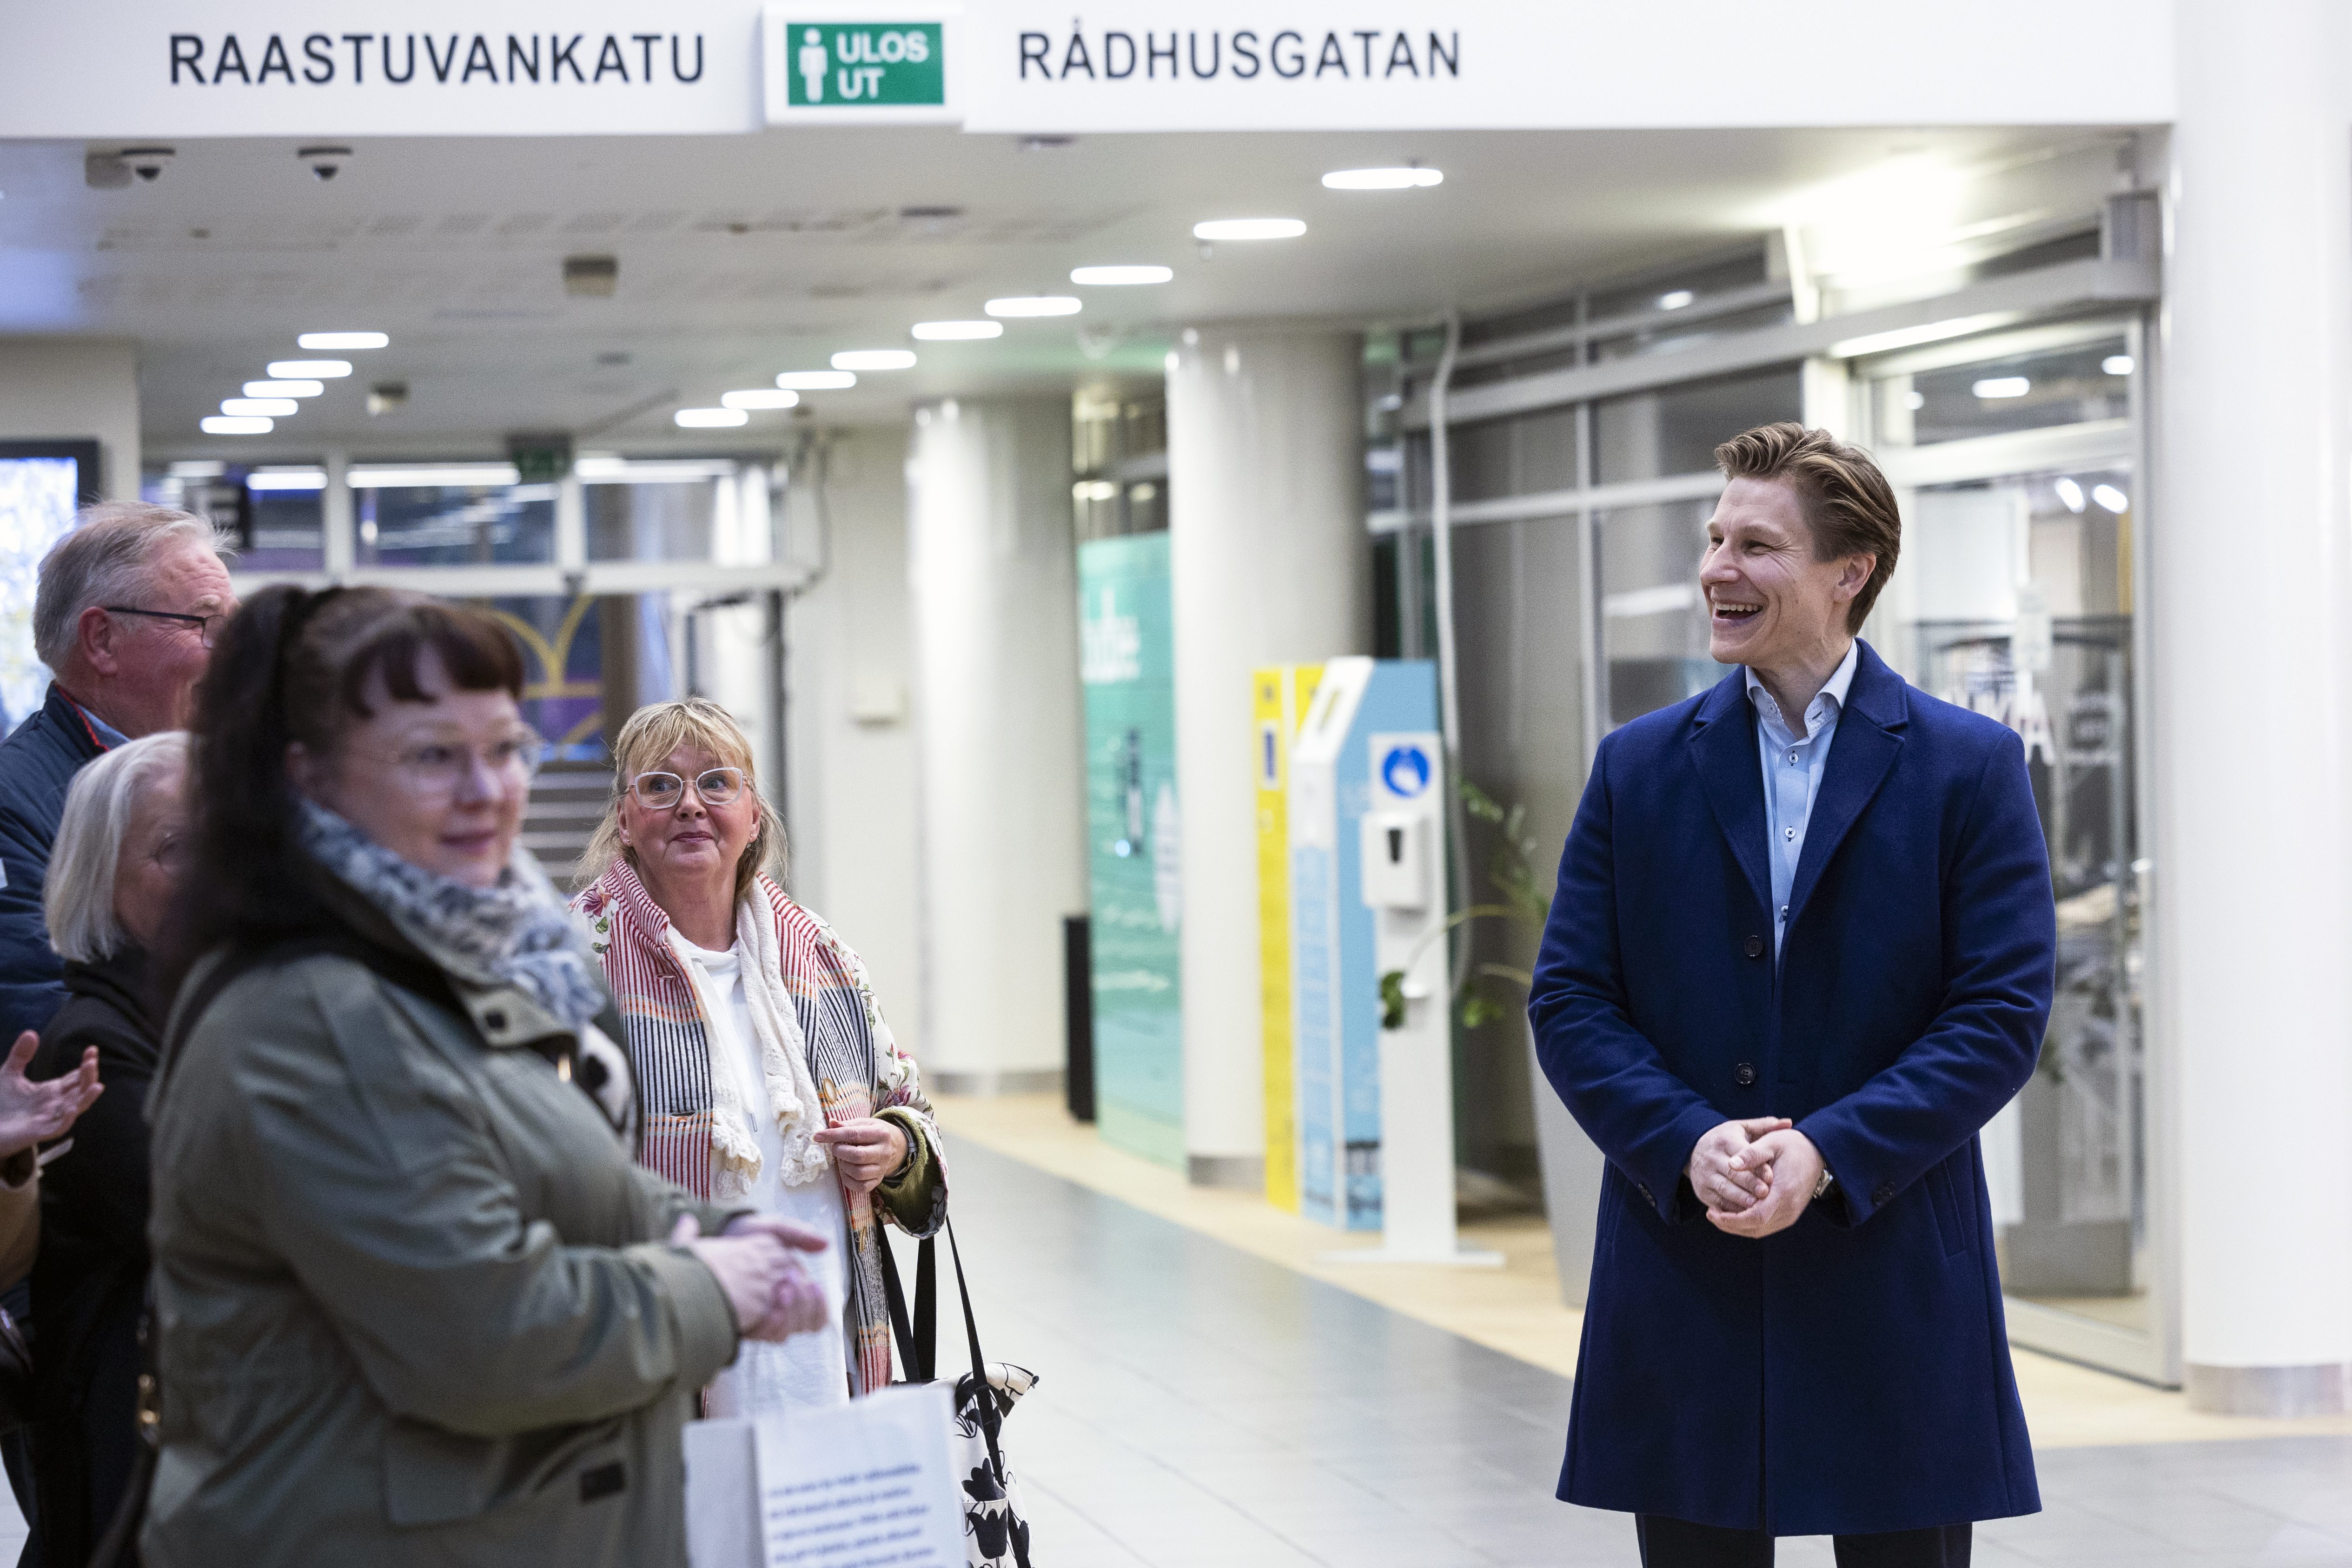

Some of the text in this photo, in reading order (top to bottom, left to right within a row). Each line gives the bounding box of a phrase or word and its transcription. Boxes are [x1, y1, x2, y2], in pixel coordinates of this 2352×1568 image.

[169, 33, 703, 85] RAASTUVANKATU
[836, 31, 929, 63] ULOS
[1020, 17, 1458, 79] RÅDHUSGATAN
[838, 68, 884, 99] UT
